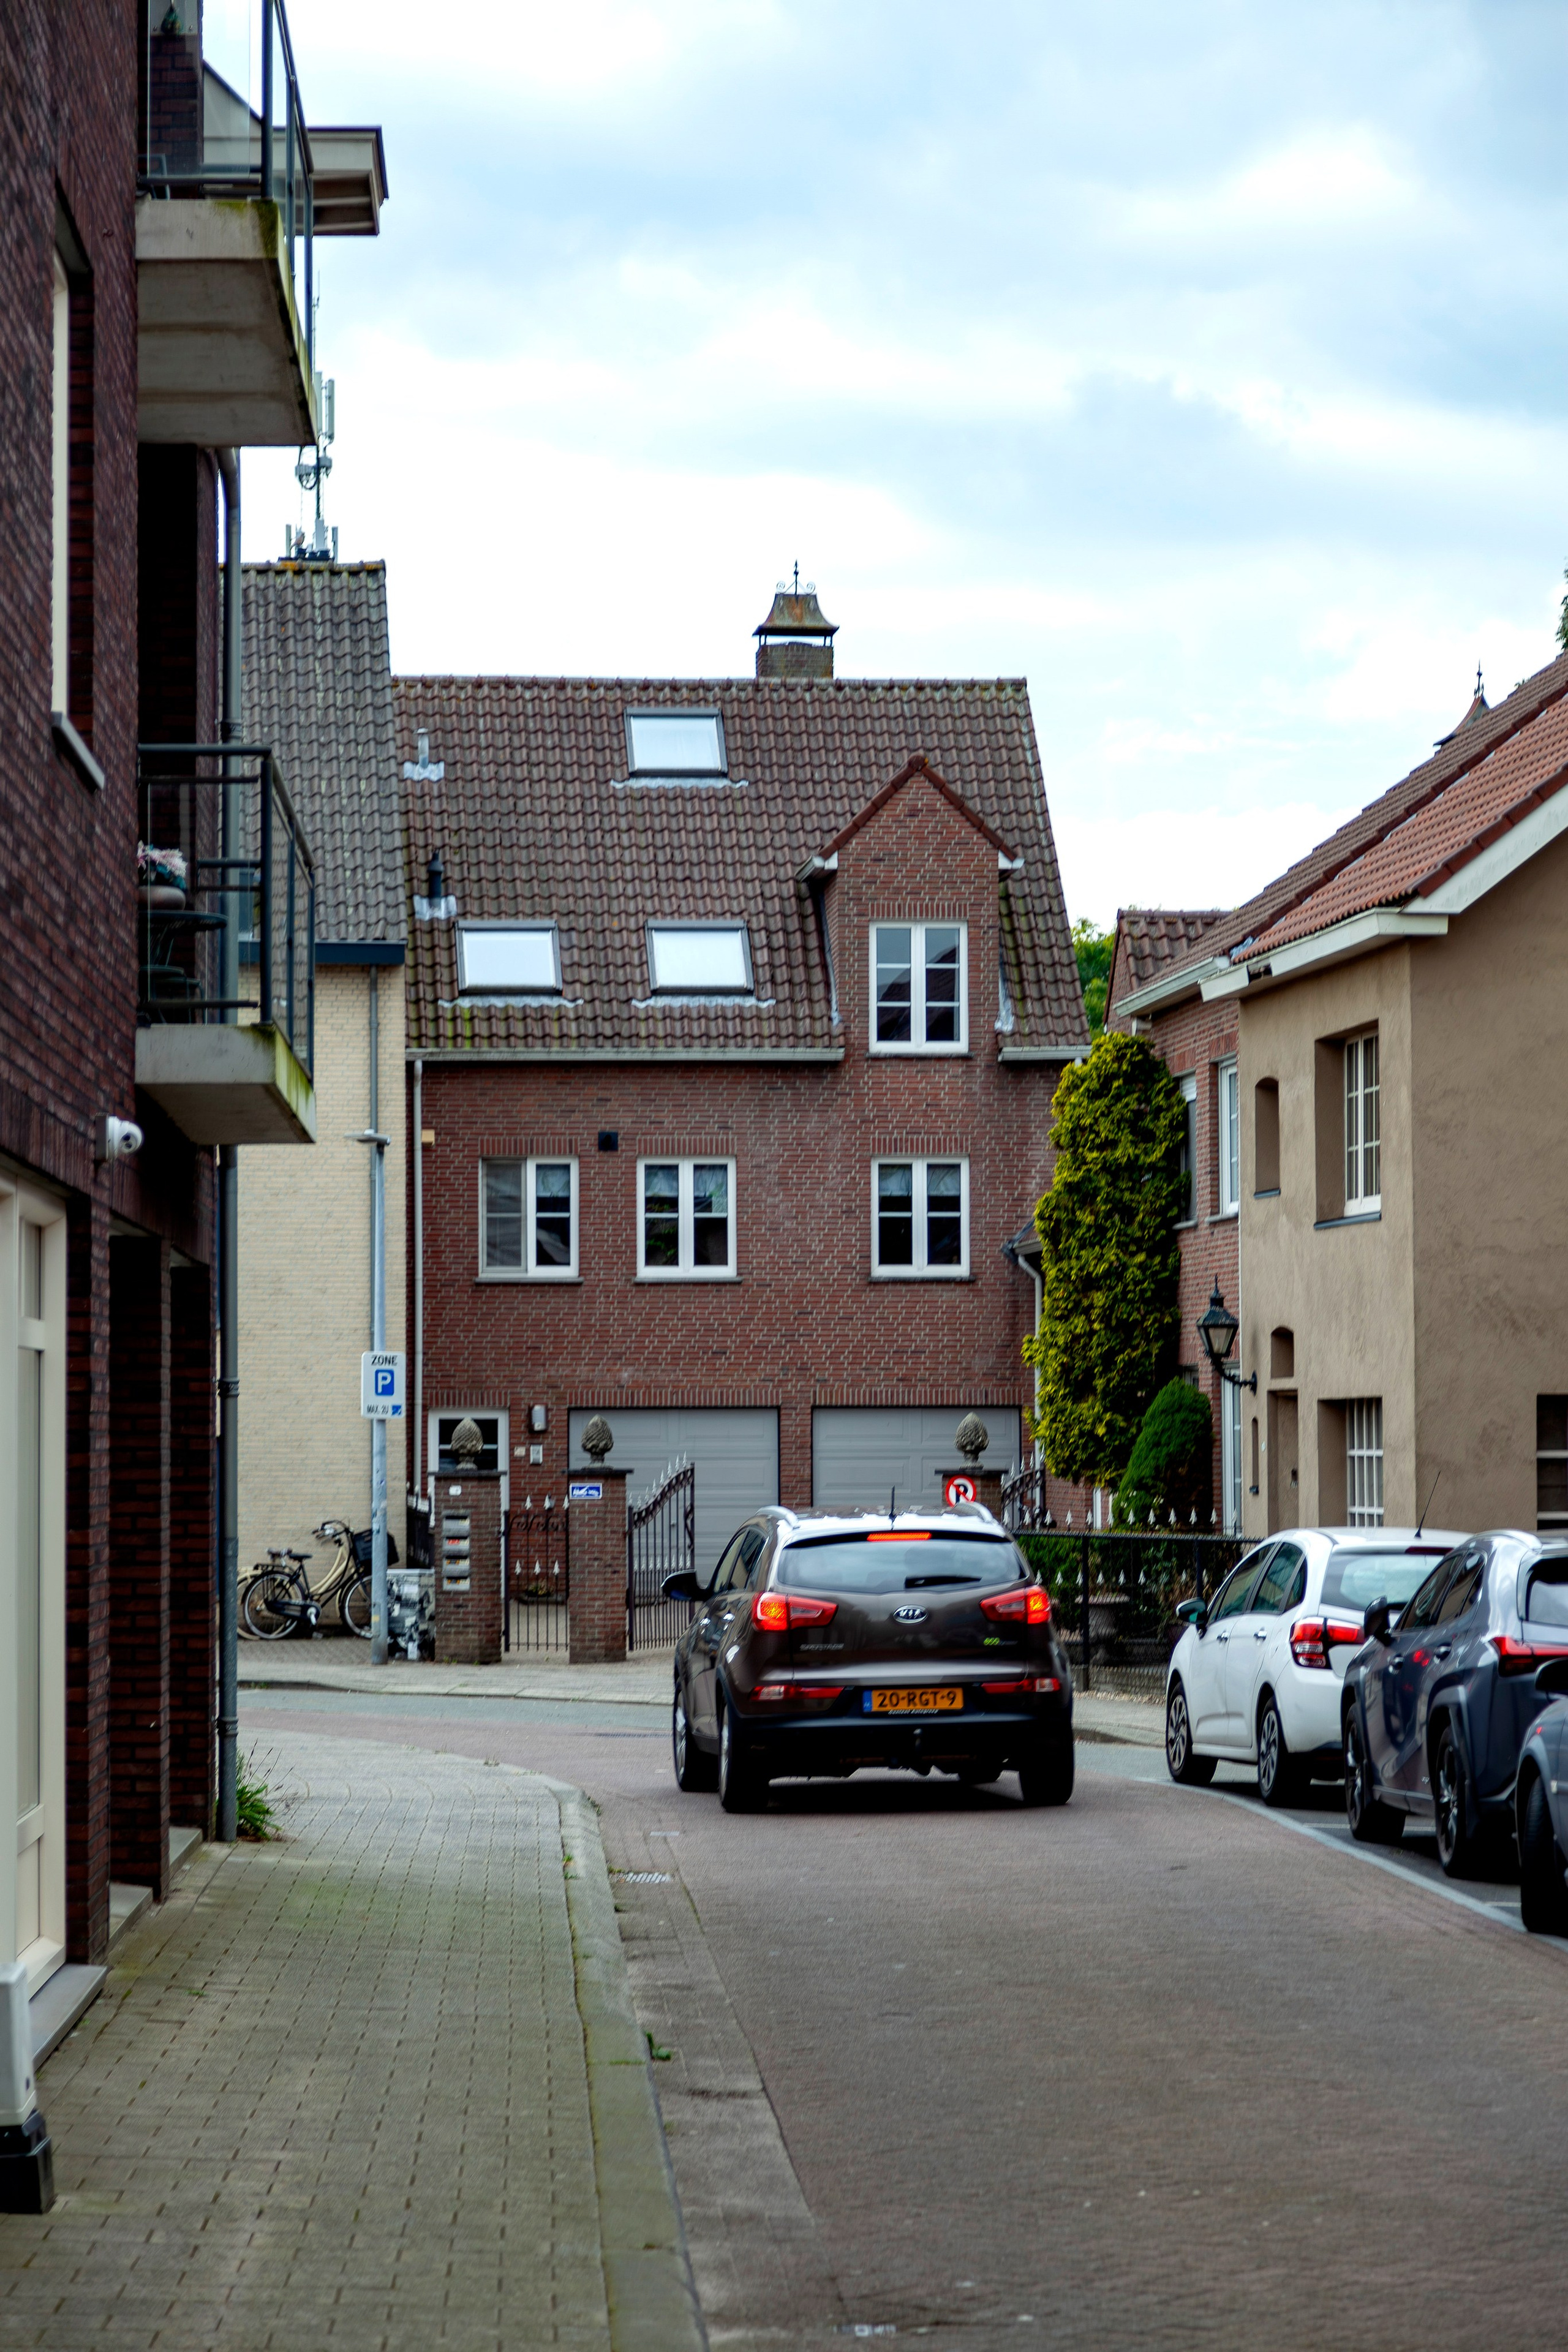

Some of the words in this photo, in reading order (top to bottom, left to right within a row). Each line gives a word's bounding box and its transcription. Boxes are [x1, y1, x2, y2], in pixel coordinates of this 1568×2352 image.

[371, 1355, 398, 1366] ZONE
[377, 1372, 391, 1393] P
[877, 1691, 957, 1708] 20-RGT-9
